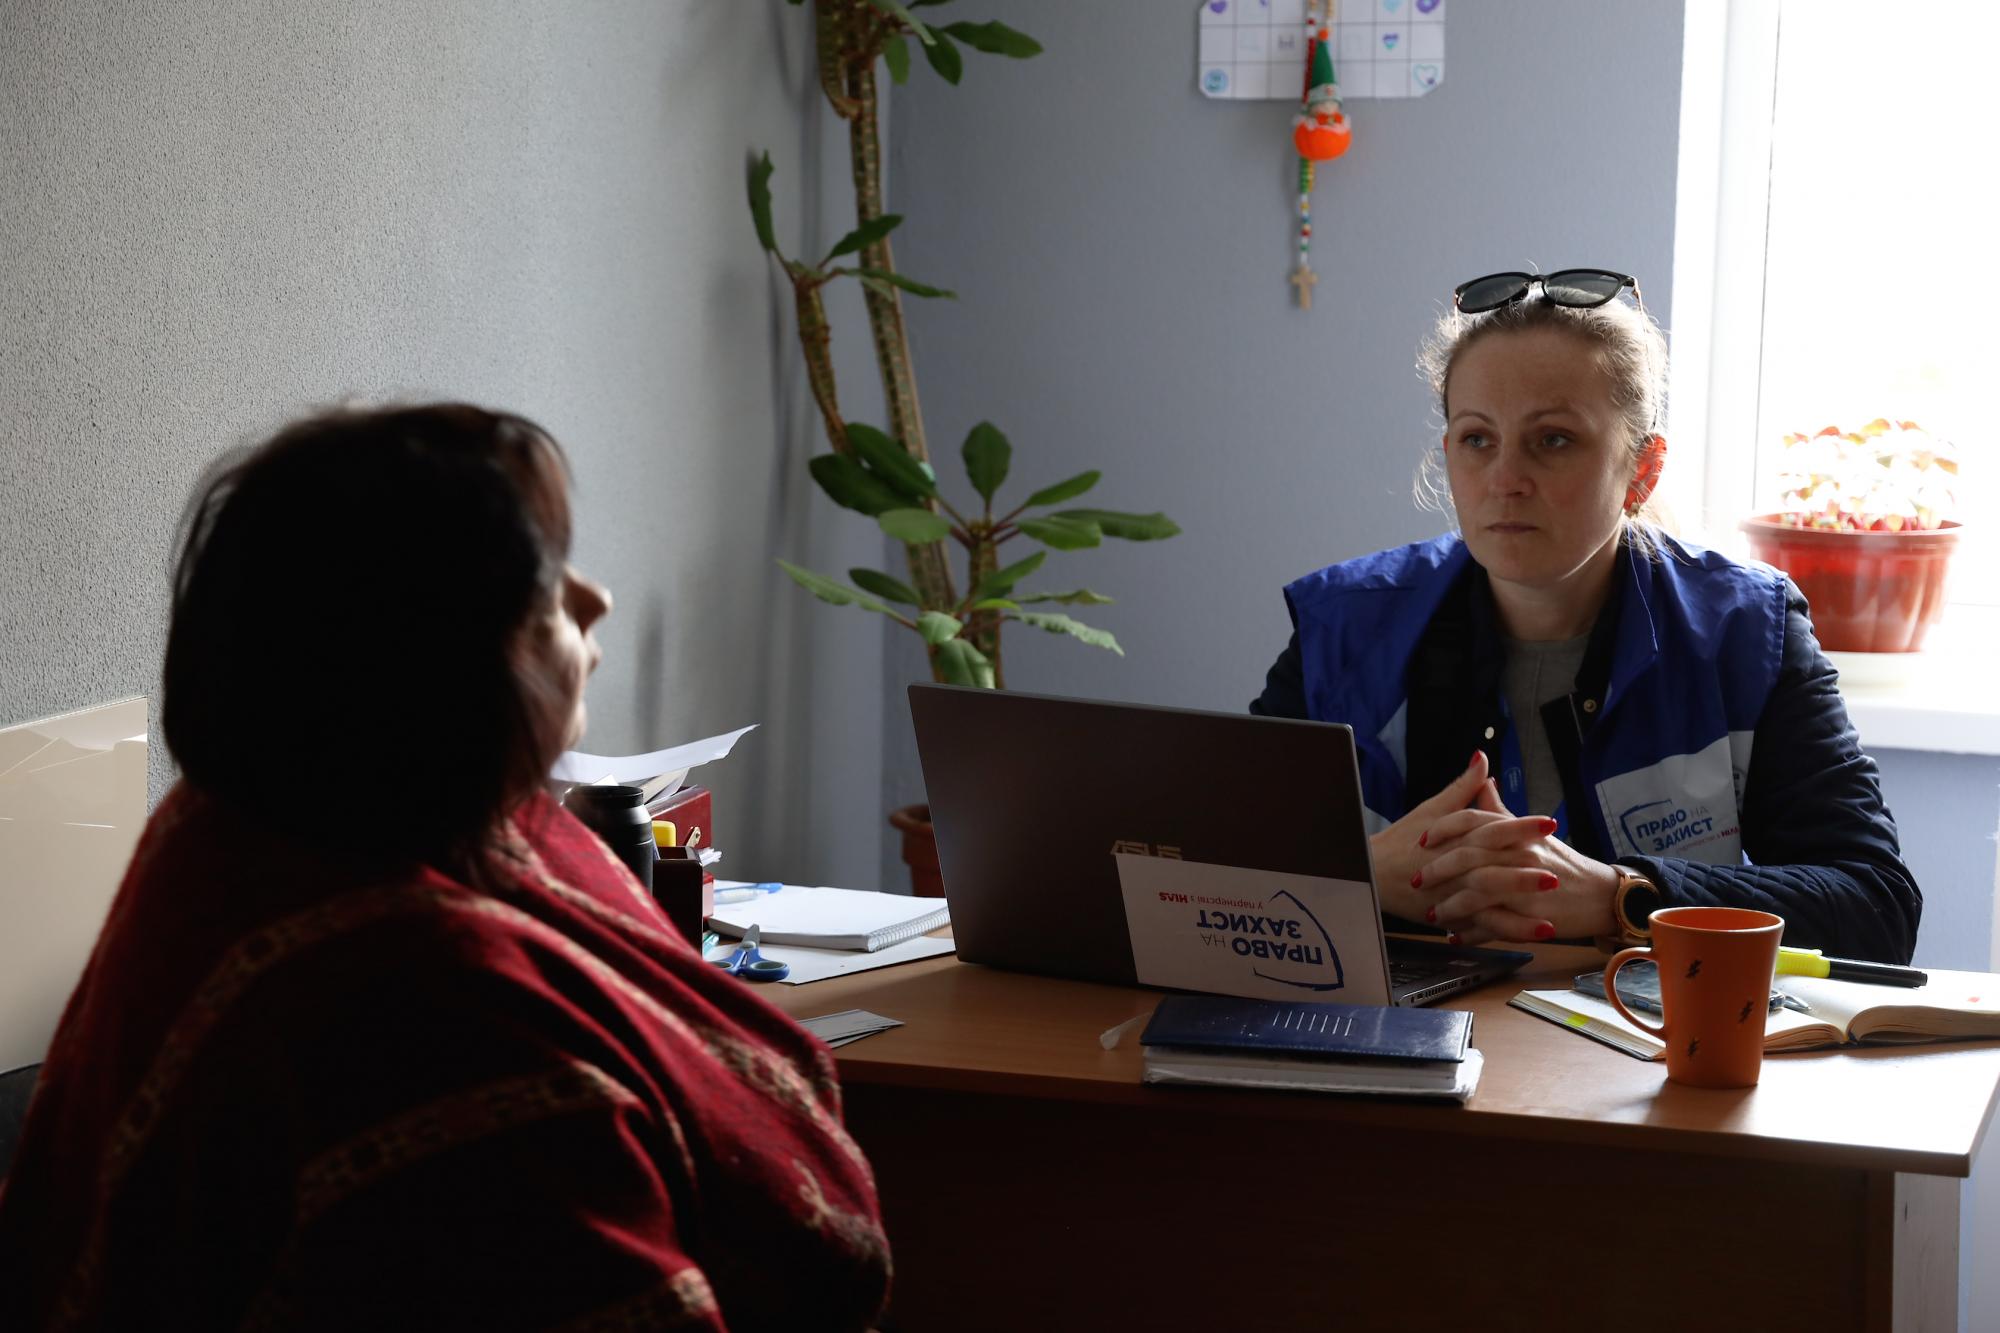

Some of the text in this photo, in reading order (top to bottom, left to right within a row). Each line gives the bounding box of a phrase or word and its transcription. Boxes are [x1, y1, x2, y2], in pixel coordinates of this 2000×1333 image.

[1636, 809, 1687, 839] ПРАВО
[1653, 817, 1713, 852] ЗАХИСТ
[1197, 894, 1256, 910] партнерстві
[1196, 909, 1303, 938] ЗАХИСТ
[1200, 933, 1323, 965] ПРАВО НА
